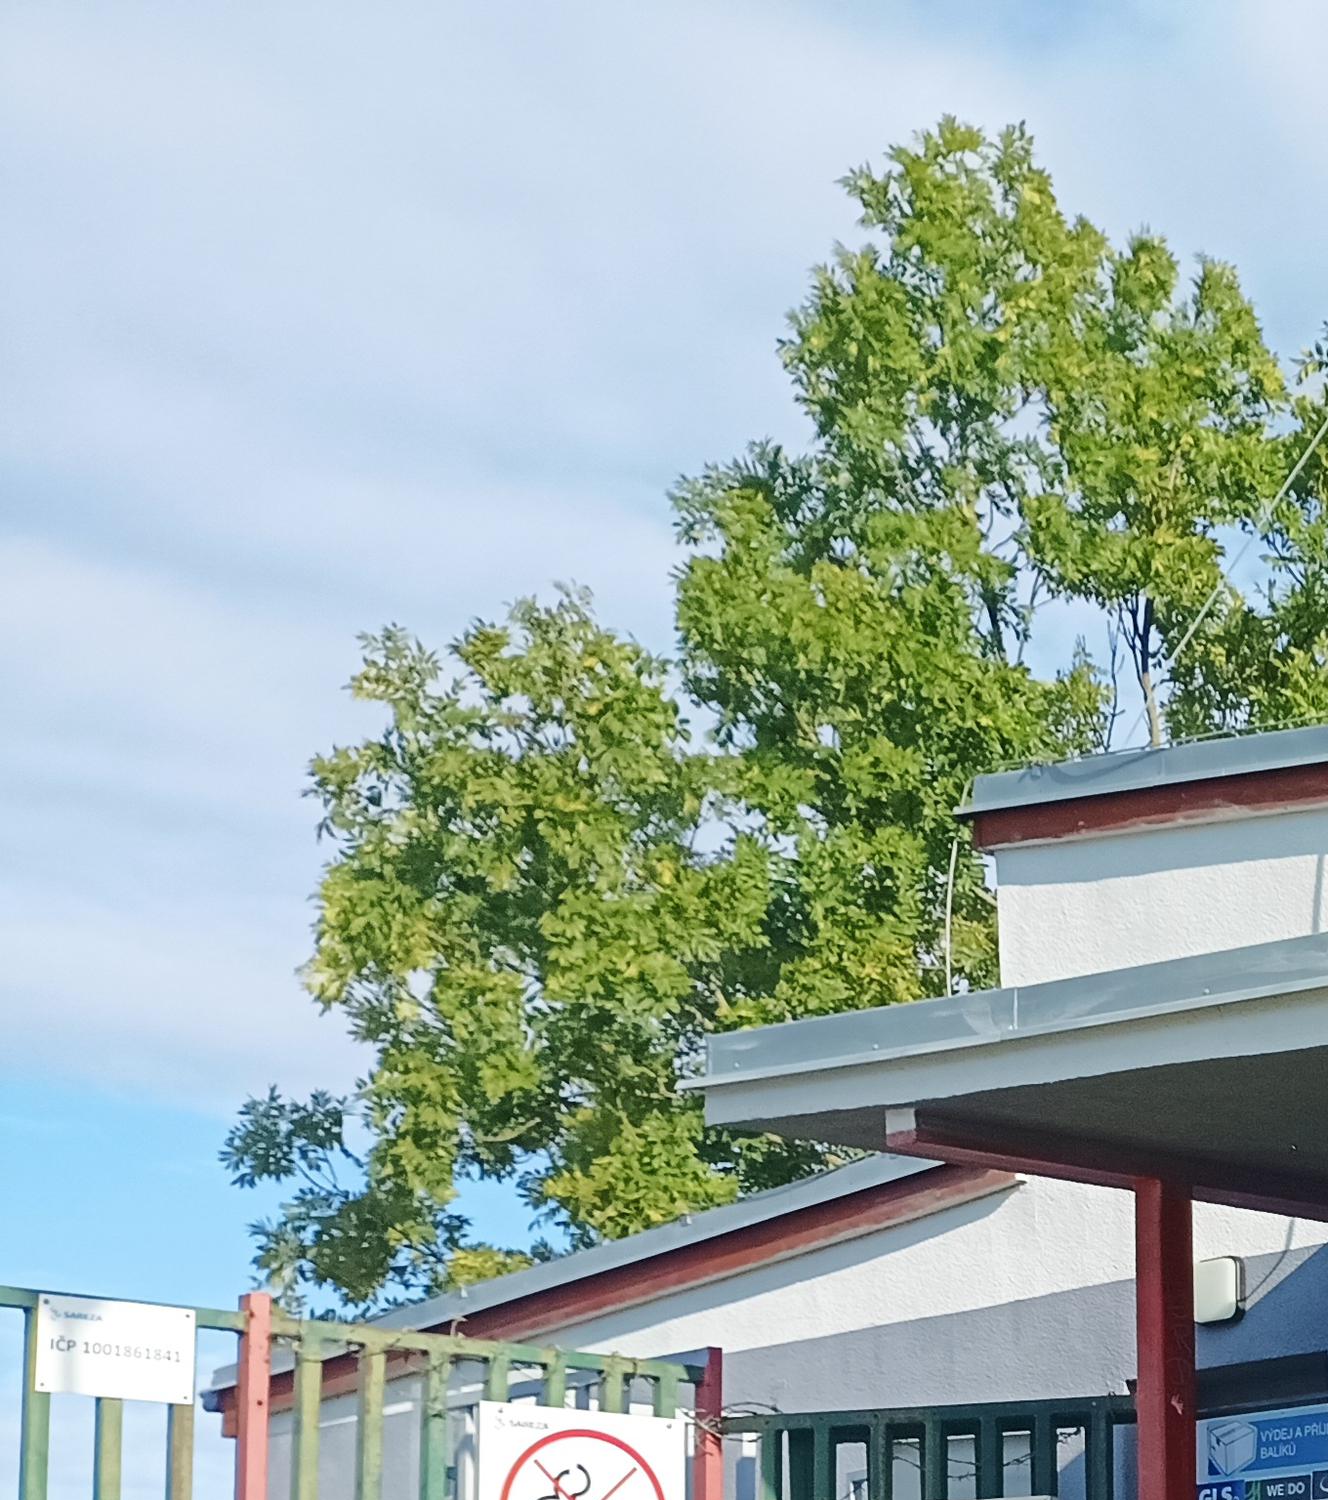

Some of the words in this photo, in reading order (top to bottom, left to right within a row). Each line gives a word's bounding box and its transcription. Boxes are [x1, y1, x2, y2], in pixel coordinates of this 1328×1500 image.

[50, 1335, 77, 1352] IČP
[83, 1341, 181, 1363] 1001861841
[1260, 1427, 1293, 1442] VÝDEJ
[1295, 1426, 1302, 1438] A
[1260, 1441, 1296, 1459] BALÍKŮ
[1266, 1484, 1285, 1497] WE
[1287, 1482, 1305, 1495] DO
